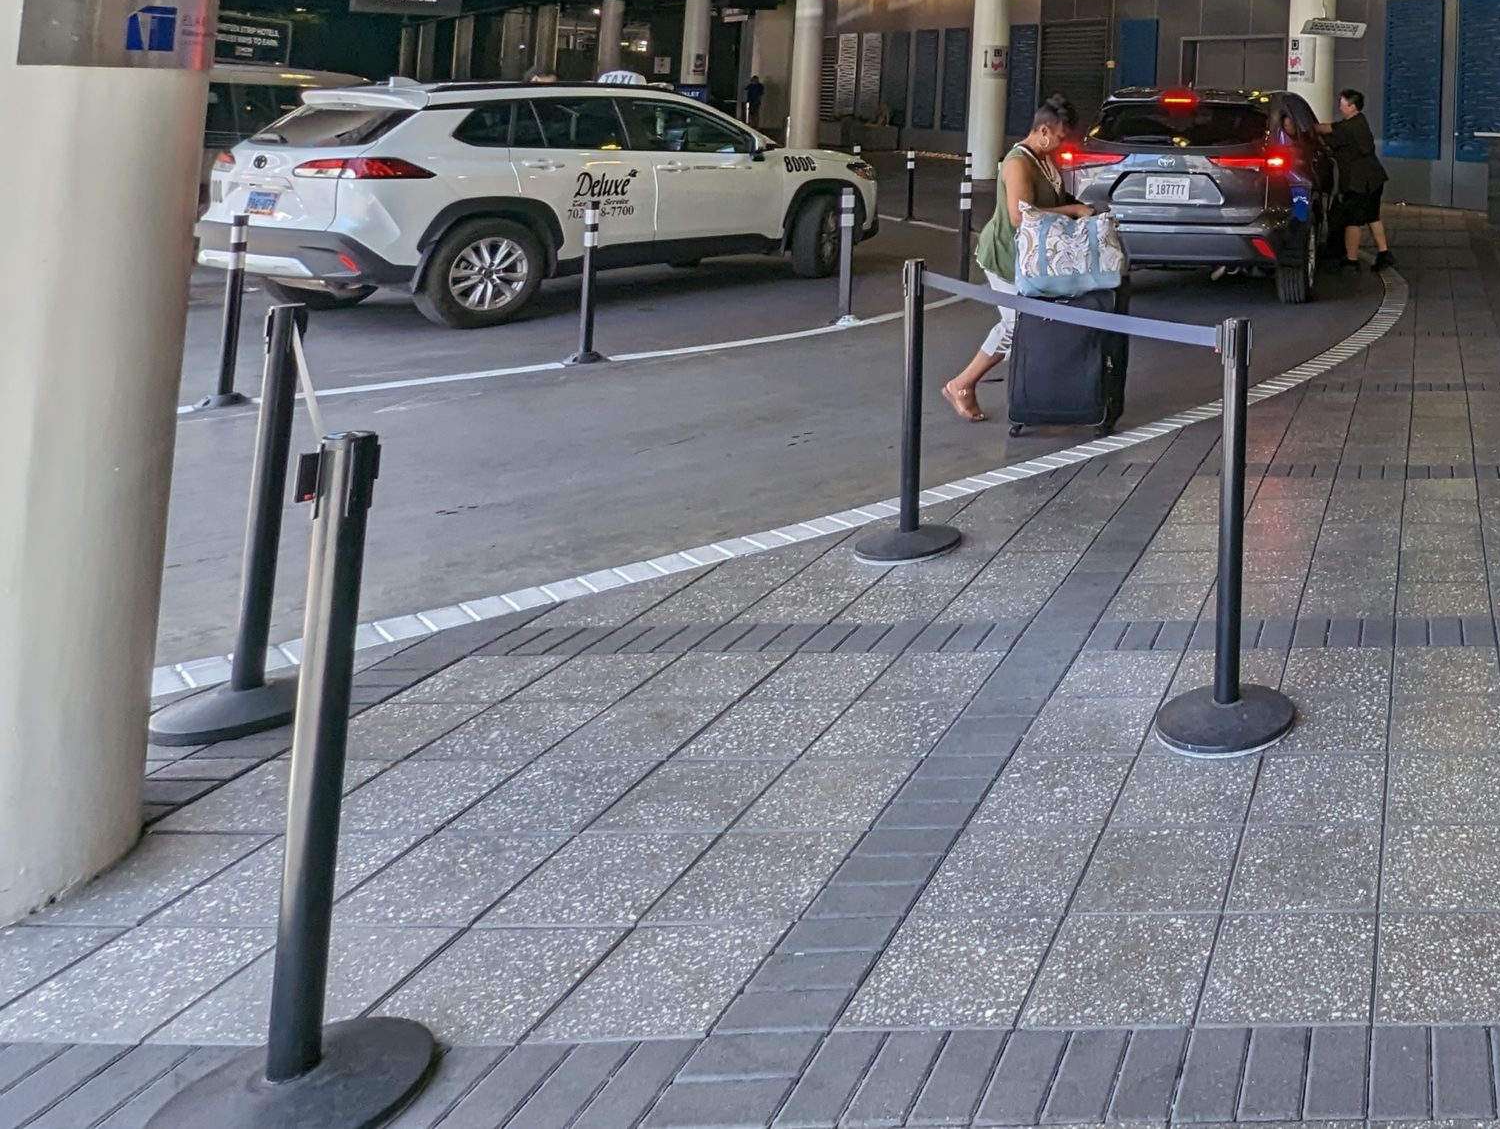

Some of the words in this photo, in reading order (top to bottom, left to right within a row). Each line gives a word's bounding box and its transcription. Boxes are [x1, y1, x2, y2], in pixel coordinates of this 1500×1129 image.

[605, 74, 633, 84] TAXI
[574, 172, 631, 198] Deluxe
[1156, 183, 1186, 196] 187777
